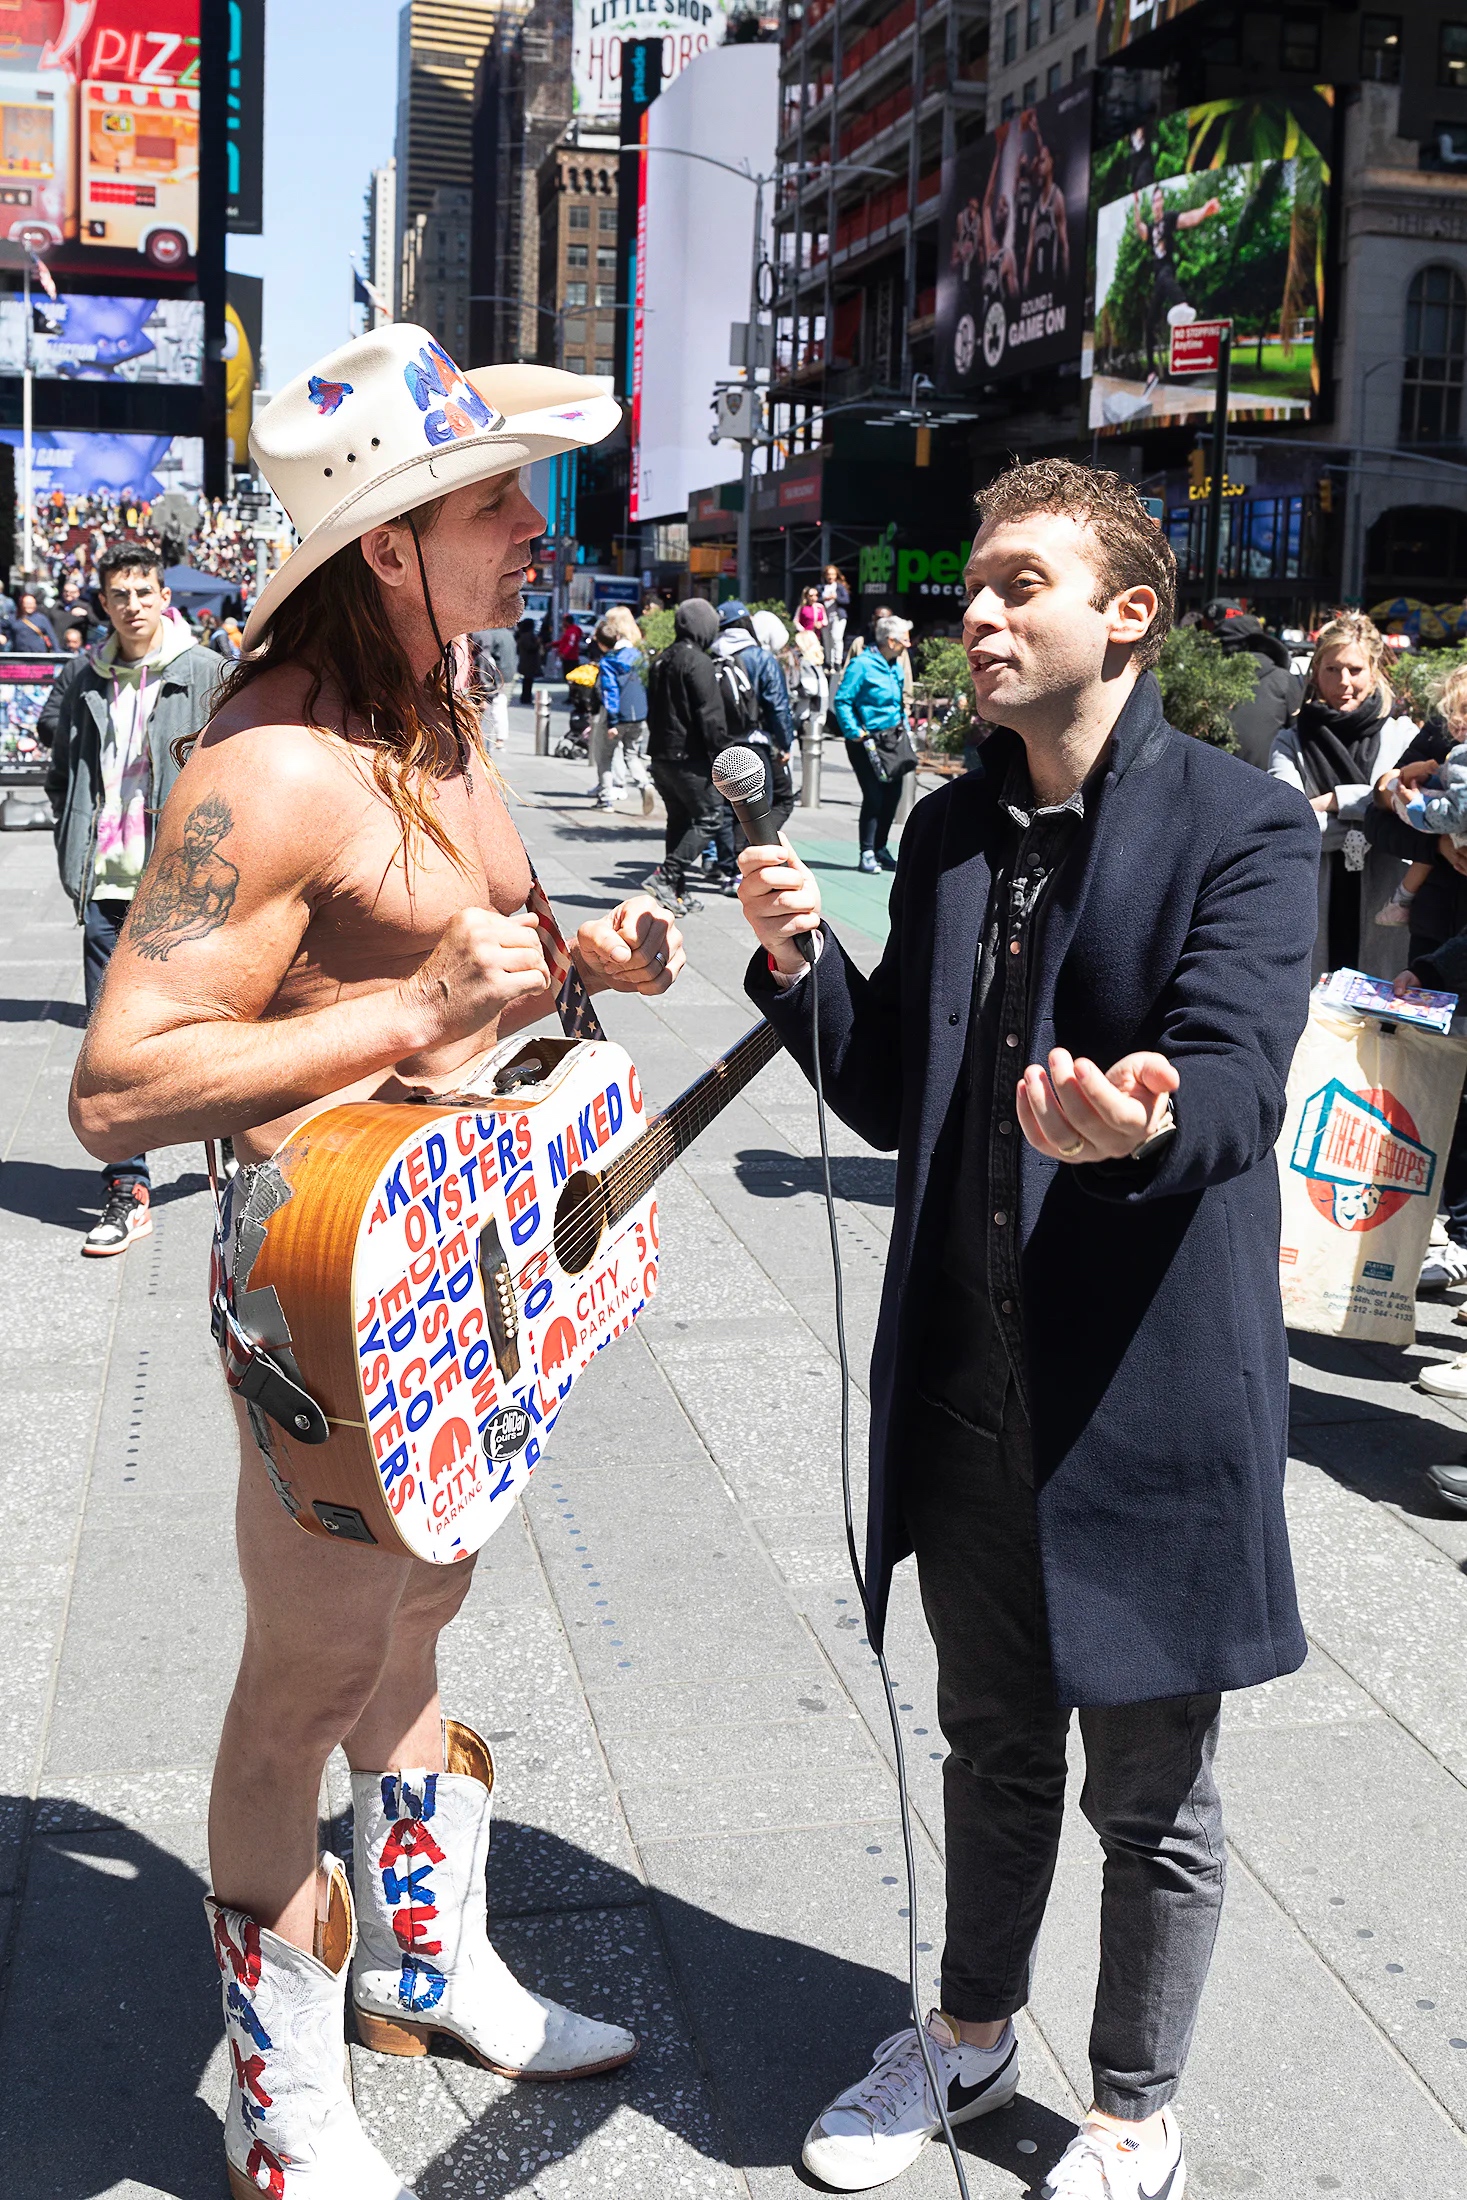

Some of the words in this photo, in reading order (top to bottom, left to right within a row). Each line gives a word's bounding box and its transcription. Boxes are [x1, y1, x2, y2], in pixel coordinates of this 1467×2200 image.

[591, 0, 658, 28] LITTLE
[665, 0, 712, 25] SHOP
[631, 45, 648, 103] phade
[1009, 313, 1044, 347] GAME
[1045, 305, 1066, 335] ON
[1021, 294, 1048, 317] ROUND
[1174, 339, 1203, 351] Anytime
[1175, 329, 1185, 339] NO
[1186, 325, 1220, 338] STOPPING
[547, 1082, 623, 1189] NAKED
[404, 1114, 532, 1253] OYSTERS
[577, 1259, 619, 1321] CITY
[579, 1277, 639, 1345] PARKING
[1353, 1306, 1368, 1314] 212
[1374, 1308, 1388, 1317] 944
[1394, 1312, 1413, 1321] 4133
[1355, 1284, 1388, 1298] Shubert
[1389, 1292, 1410, 1303] Alley
[432, 1454, 479, 1518] CITY
[435, 1481, 484, 1535] PARKING
[379, 1773, 448, 2012] NAKED
[1122, 2137, 1141, 2150] NIKE
